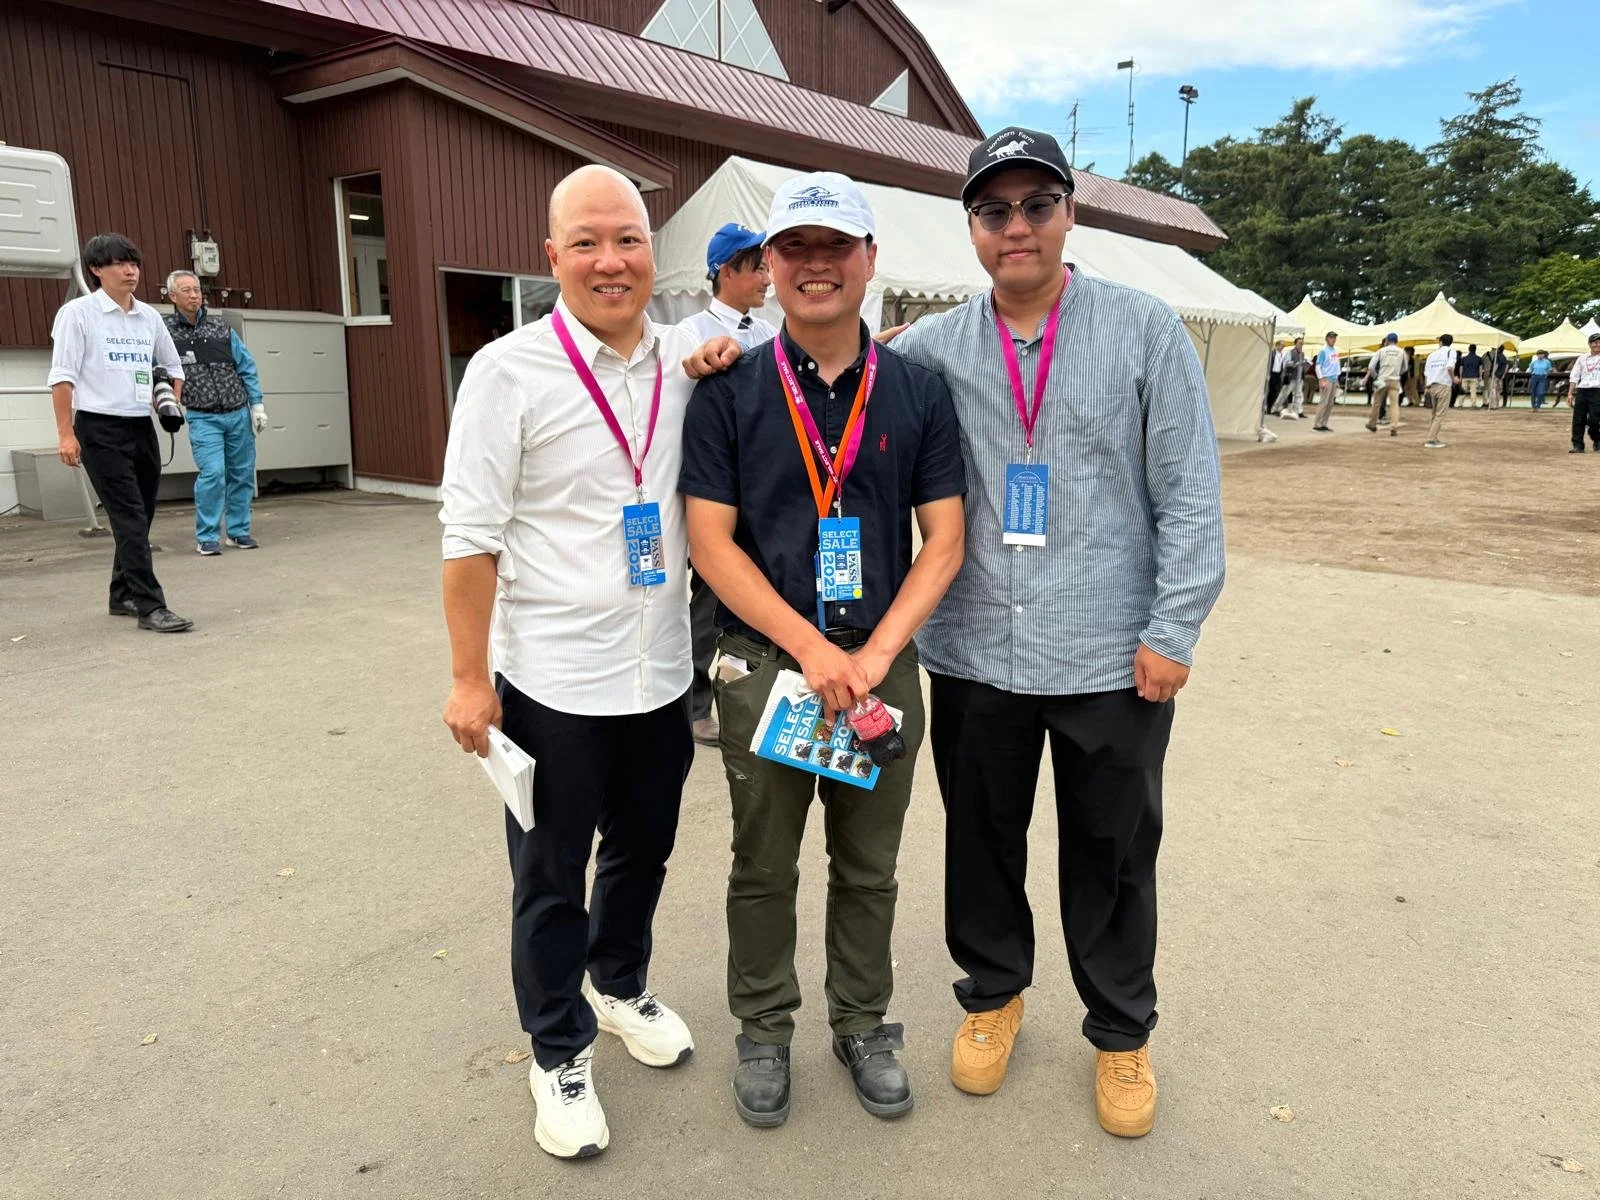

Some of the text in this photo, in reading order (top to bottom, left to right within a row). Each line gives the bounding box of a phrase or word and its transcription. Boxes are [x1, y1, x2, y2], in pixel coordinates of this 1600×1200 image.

[986, 130, 1036, 153] Northern Farm
[106, 337, 135, 345] SELECT
[626, 515, 659, 526] SELECT
[627, 523, 660, 537] SALE
[822, 530, 858, 539] SELECT
[822, 538, 858, 550] SALE
[628, 542, 641, 586] 2025
[651, 538, 661, 568] PASS
[823, 554, 836, 598] 2025
[848, 553, 858, 582] PASS
[774, 702, 804, 756] SELEC
[797, 694, 821, 738] SALE
